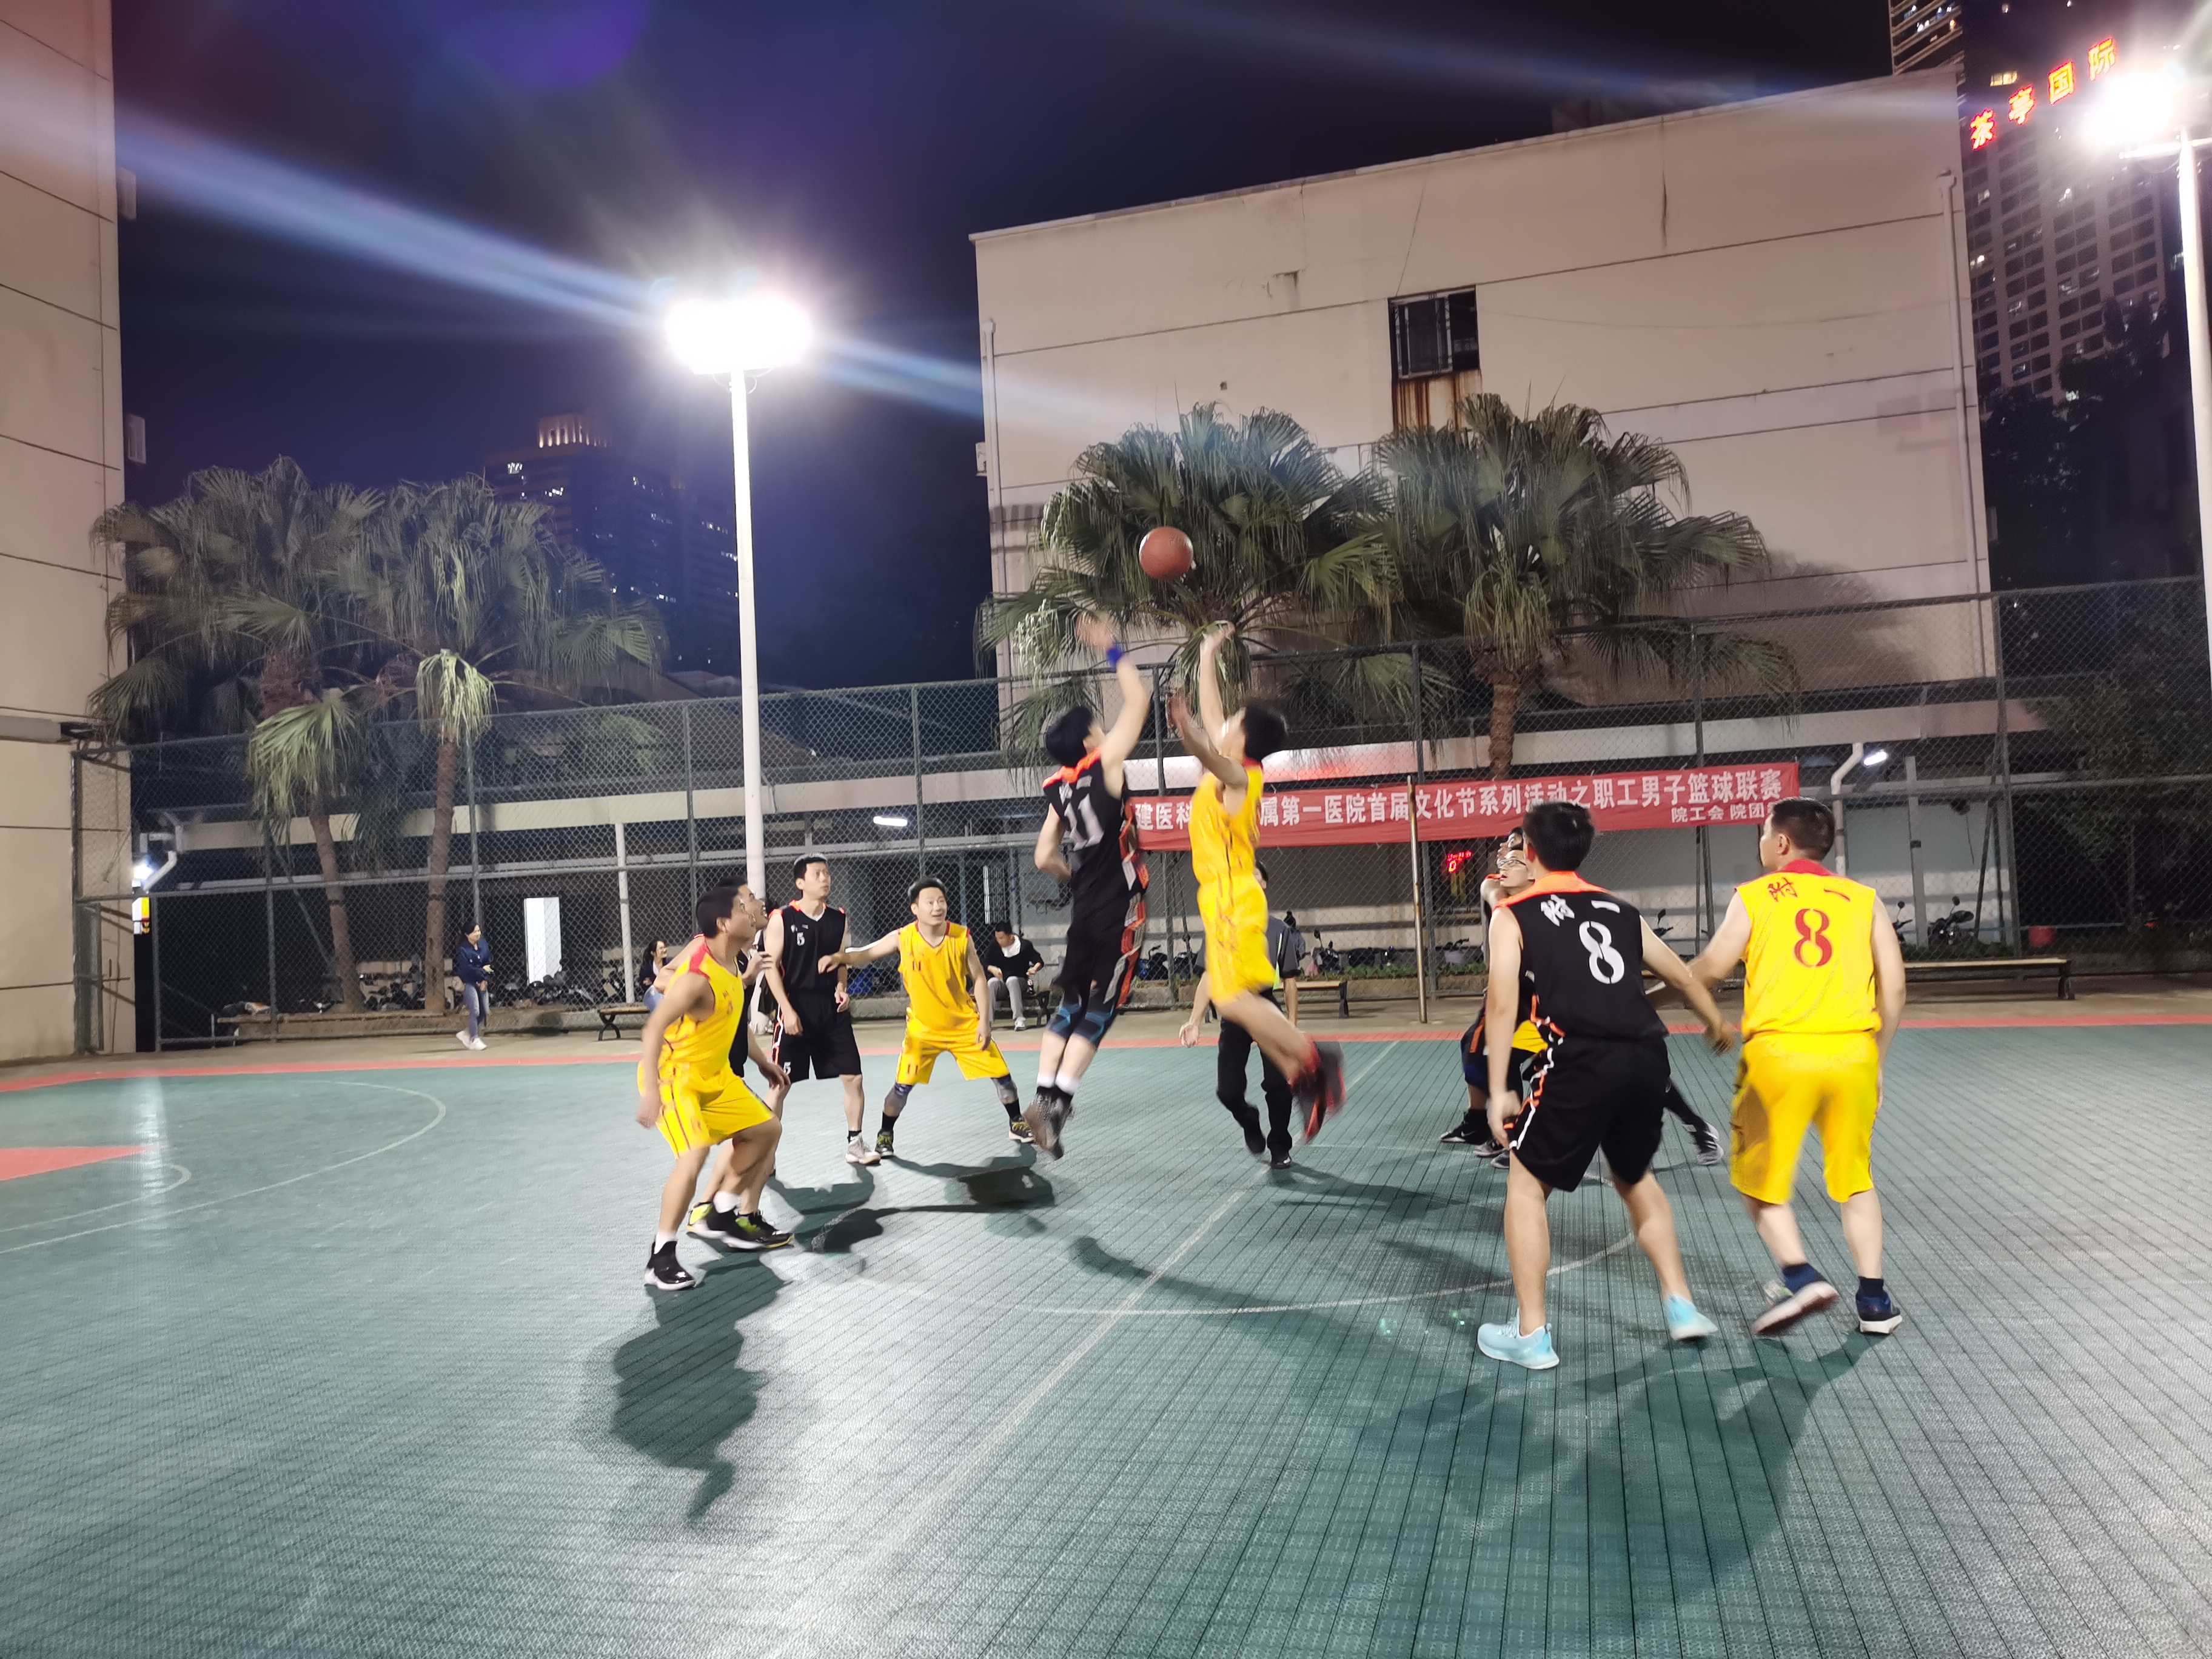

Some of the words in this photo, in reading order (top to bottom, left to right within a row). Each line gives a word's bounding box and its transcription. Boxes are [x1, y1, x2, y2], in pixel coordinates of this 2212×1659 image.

[1971, 37, 2116, 150] 茶亭国际
[1671, 805, 1724, 823] 院工会
[797, 932, 805, 946] 5
[1579, 921, 1624, 984] 8
[1794, 908, 1833, 968] 8
[783, 1062, 791, 1075] 5
